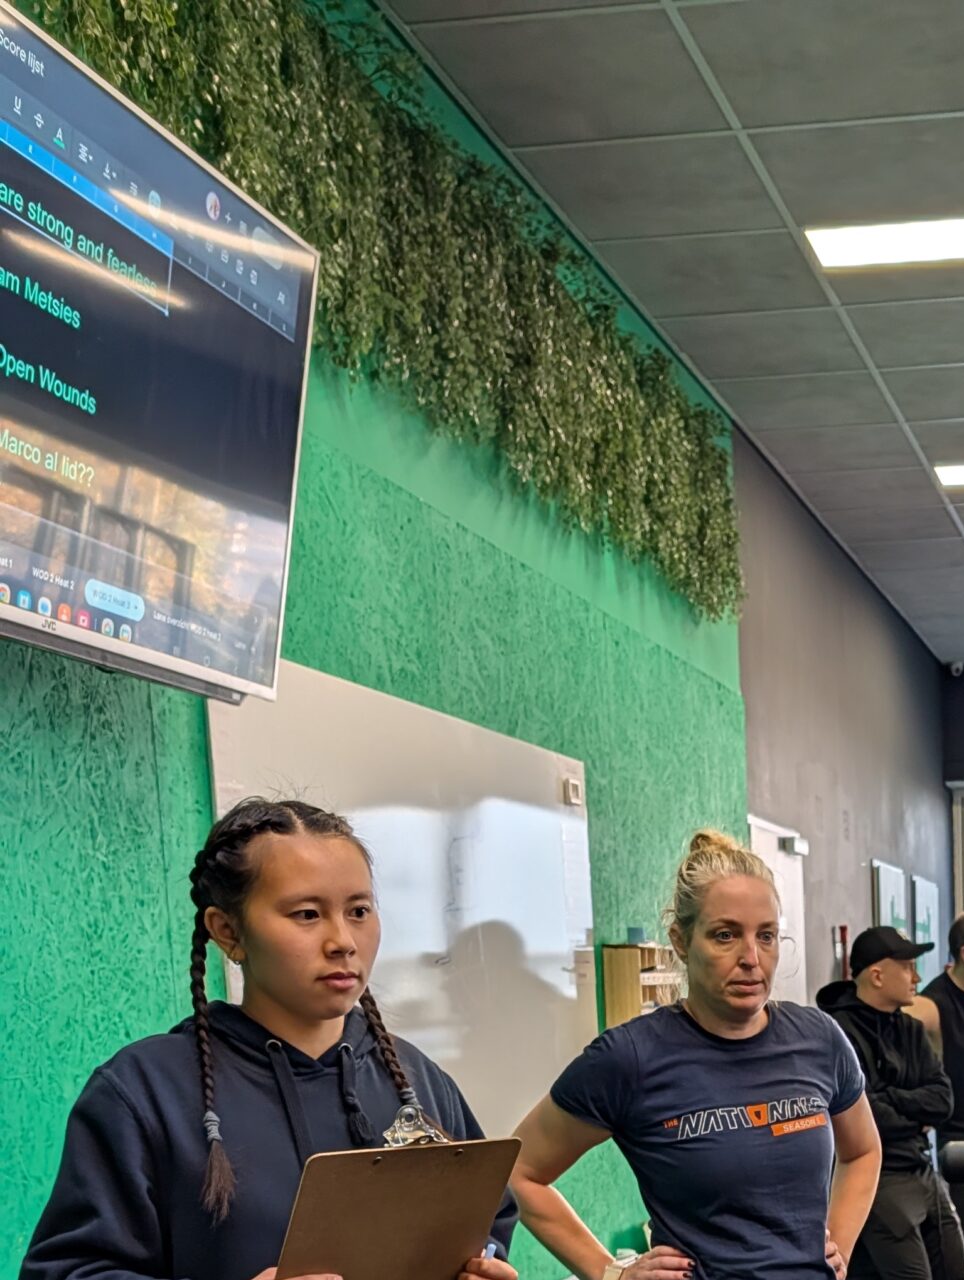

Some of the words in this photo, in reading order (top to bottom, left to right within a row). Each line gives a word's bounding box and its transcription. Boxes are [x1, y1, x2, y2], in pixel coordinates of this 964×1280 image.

[27, 51, 45, 77] lijst
[0, 183, 24, 213] are
[28, 202, 74, 249] strong
[77, 234, 104, 263] and
[107, 248, 157, 298] fearless
[24, 277, 81, 329] Metsies
[38, 365, 97, 415] Wounds
[44, 451, 58, 472] al
[61, 455, 95, 488] lid??
[32, 566, 49, 581] WOD
[41, 618, 57, 632] JVC
